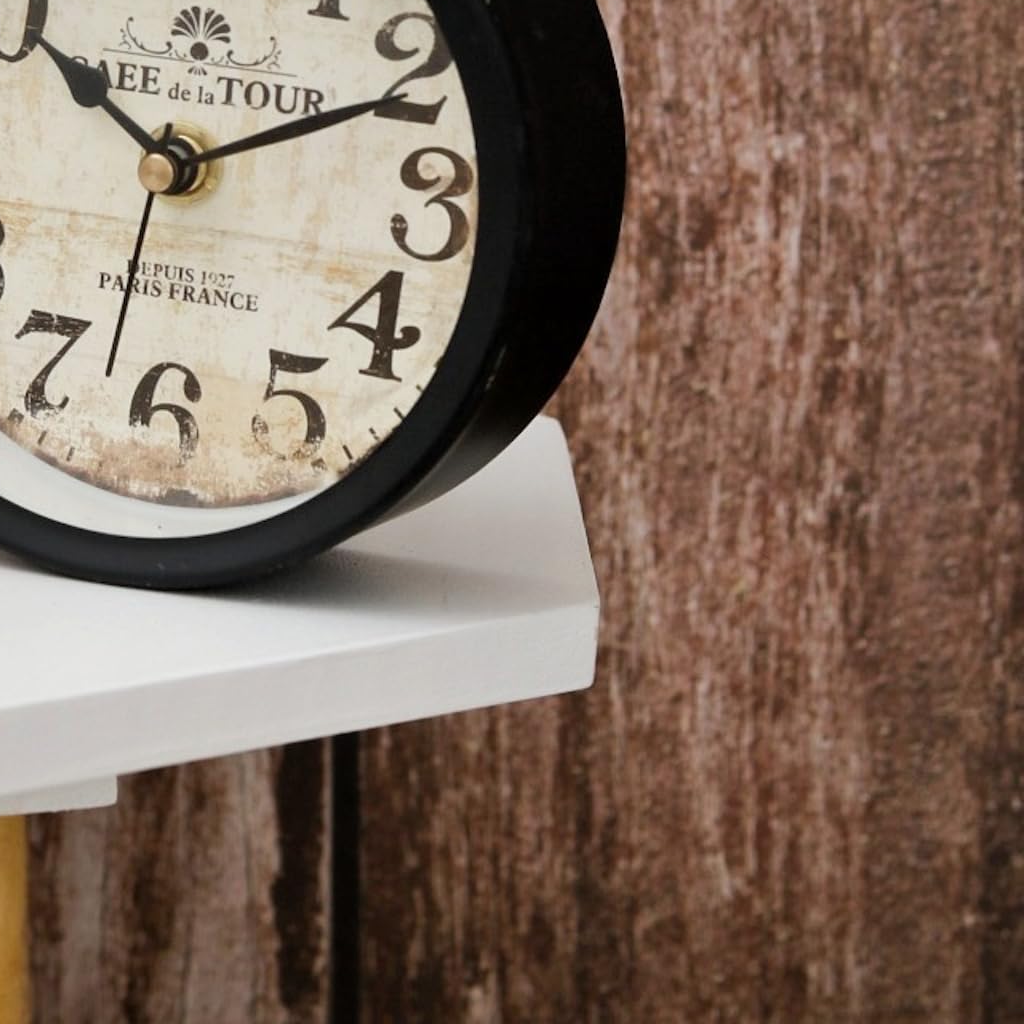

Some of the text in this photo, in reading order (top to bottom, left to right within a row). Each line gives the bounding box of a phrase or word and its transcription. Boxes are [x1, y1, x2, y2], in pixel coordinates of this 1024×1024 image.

[167, 83, 191, 100] de
[197, 88, 215, 105] la
[217, 76, 325, 115] TOUR
[373, 12, 453, 125] 2
[390, 146, 474, 262] 3
[98, 271, 259, 312] PARIS FRANCE
[201, 271, 236, 289] 1927
[328, 270, 421, 381] 4
[15, 309, 94, 419] 7
[128, 362, 202, 468] 6
[251, 348, 329, 460] 5
